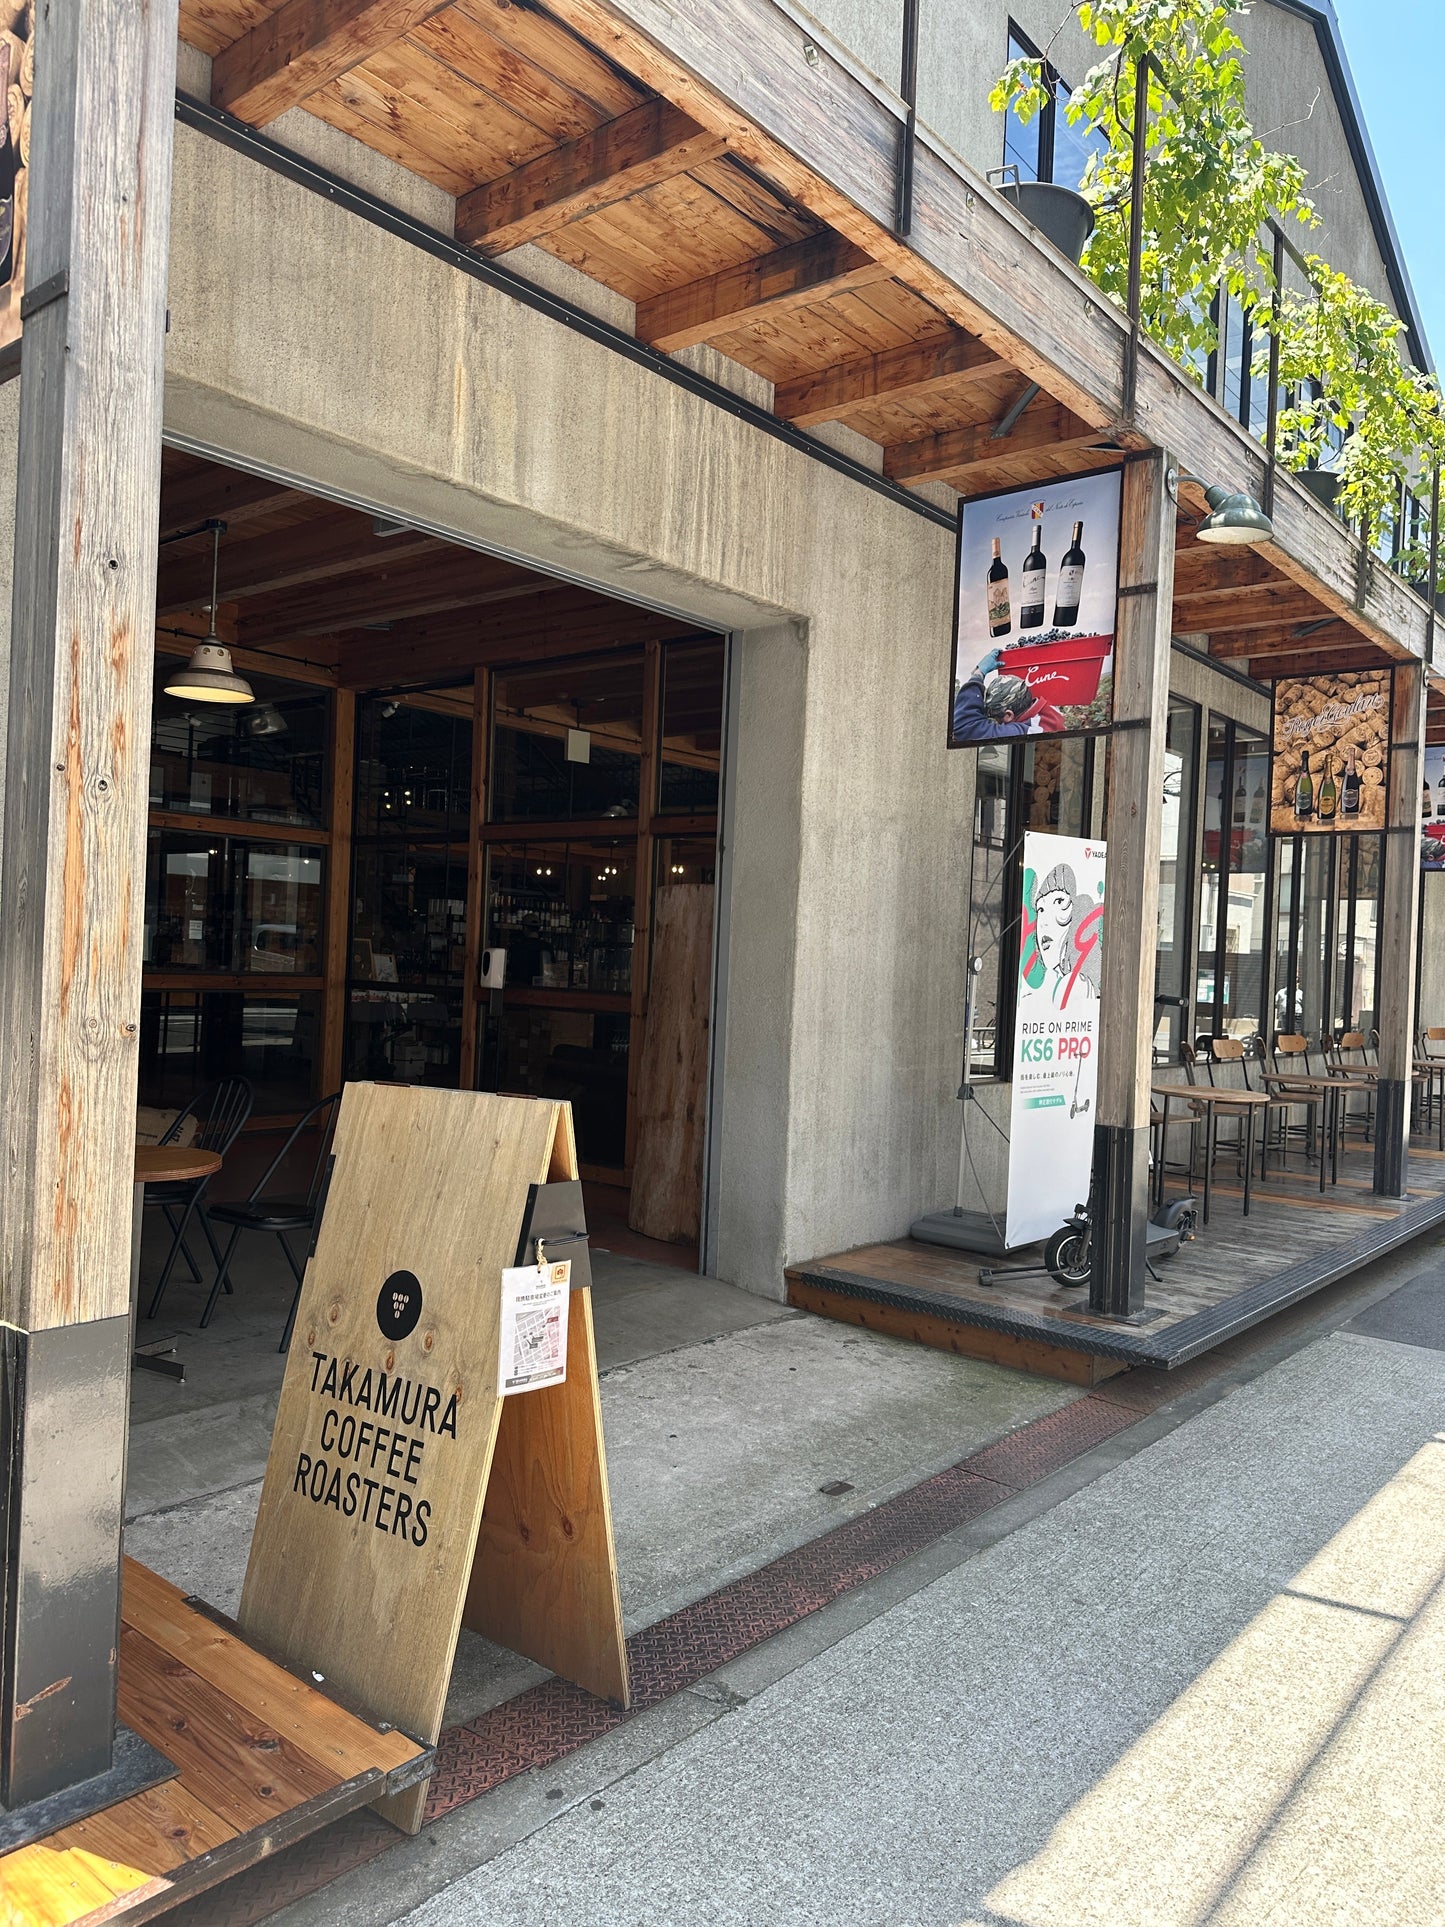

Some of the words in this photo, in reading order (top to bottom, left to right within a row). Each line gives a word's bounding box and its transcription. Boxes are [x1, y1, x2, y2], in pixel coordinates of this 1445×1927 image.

[1025, 665, 1070, 687] Cune
[1021, 1038, 1053, 1062] KS6
[1058, 1036, 1091, 1060] PRO
[1022, 1022, 1045, 1034] RIDE
[1048, 1021, 1062, 1034] ON
[1065, 1020, 1092, 1032] PRIME
[311, 1351, 458, 1440] TAKAMURA
[320, 1409, 425, 1485] COFFEE
[293, 1452, 432, 1547] ROASTERS
